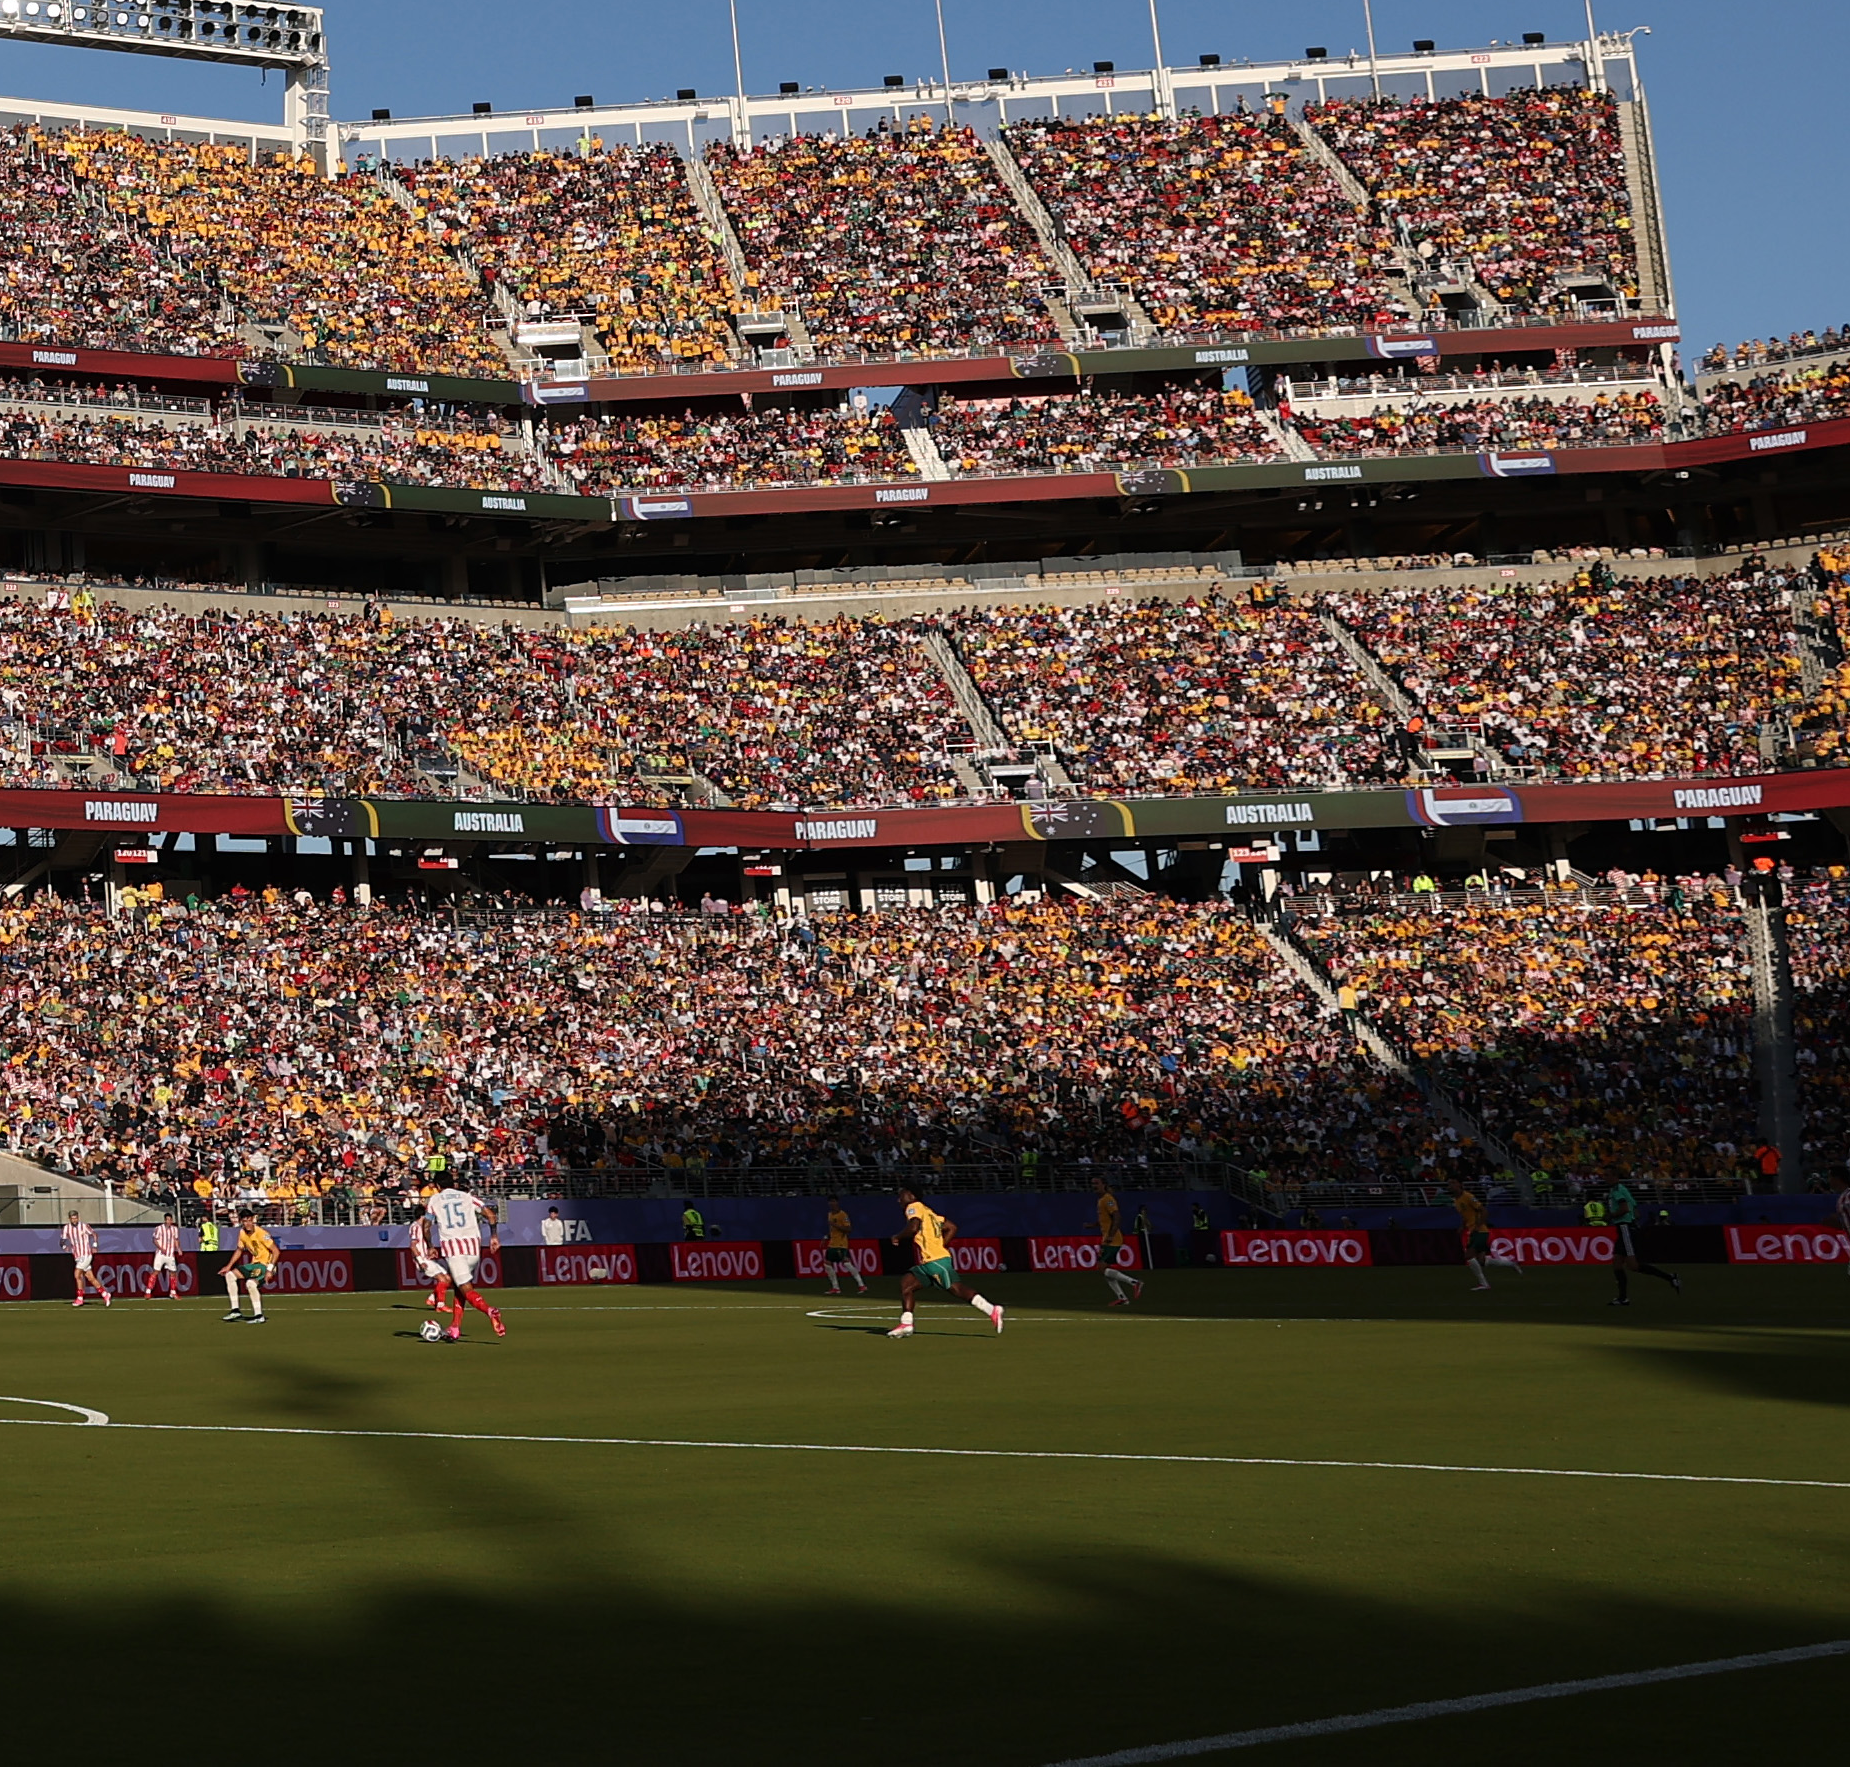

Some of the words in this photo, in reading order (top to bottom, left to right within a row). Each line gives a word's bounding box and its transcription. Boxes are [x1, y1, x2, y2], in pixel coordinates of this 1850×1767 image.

[33, 351, 76, 365] PARAGUAY
[1196, 349, 1248, 362] AUSTRALIA
[387, 378, 428, 392] AUSTRALIA
[773, 373, 822, 386] PARAGUAY
[1750, 431, 1806, 450] PARAGUAY
[130, 474, 174, 488] PARAGUAY
[1305, 466, 1362, 480] AUSTRALIA
[483, 497, 526, 510] AUSTRALIA
[875, 487, 929, 503] PARAGUAY
[1674, 785, 1761, 808] PARAGUAY
[86, 801, 157, 822] PARAGUAY
[1227, 803, 1313, 824] AUSTRALIA
[455, 812, 524, 832] AUSTRALIA
[795, 820, 876, 839] PARAGUAY
[813, 896, 841, 905] STORE
[878, 894, 906, 902] STORE
[939, 893, 967, 902] STORE
[443, 1203, 465, 1228] 15
[1031, 1239, 1135, 1269] Lenoo
[1227, 1234, 1363, 1264] Lenovo
[1489, 1236, 1615, 1262] enovo
[541, 1249, 631, 1284] Lenovo
[675, 1246, 758, 1279] Lenovo
